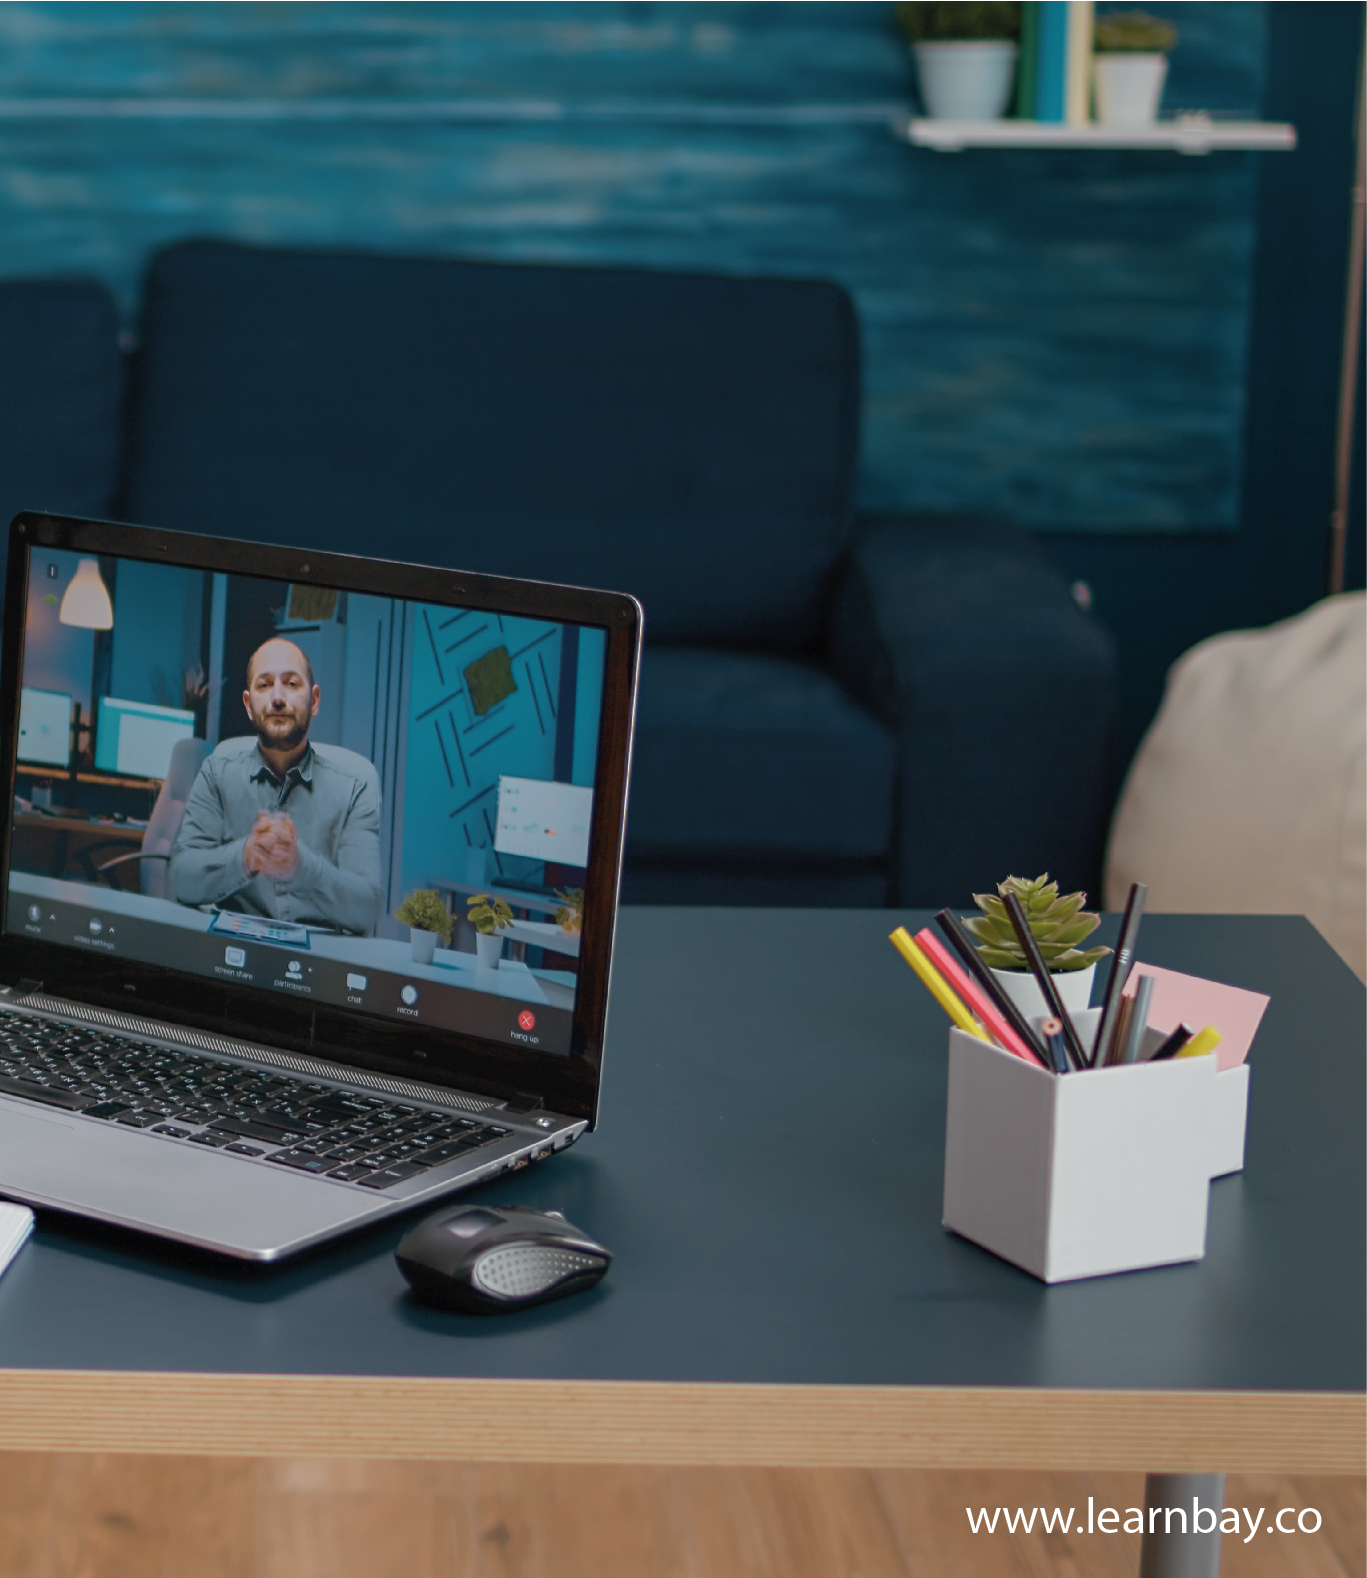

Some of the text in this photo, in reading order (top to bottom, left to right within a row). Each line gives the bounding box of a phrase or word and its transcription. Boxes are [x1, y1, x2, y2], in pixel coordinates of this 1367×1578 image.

[25, 923, 41, 934] mute
[74, 934, 114, 950] video settings
[214, 965, 253, 980] screen share
[274, 979, 311, 993] participants
[347, 995, 362, 1004] chat
[396, 1006, 418, 1017] record
[510, 1030, 539, 1044] hang up
